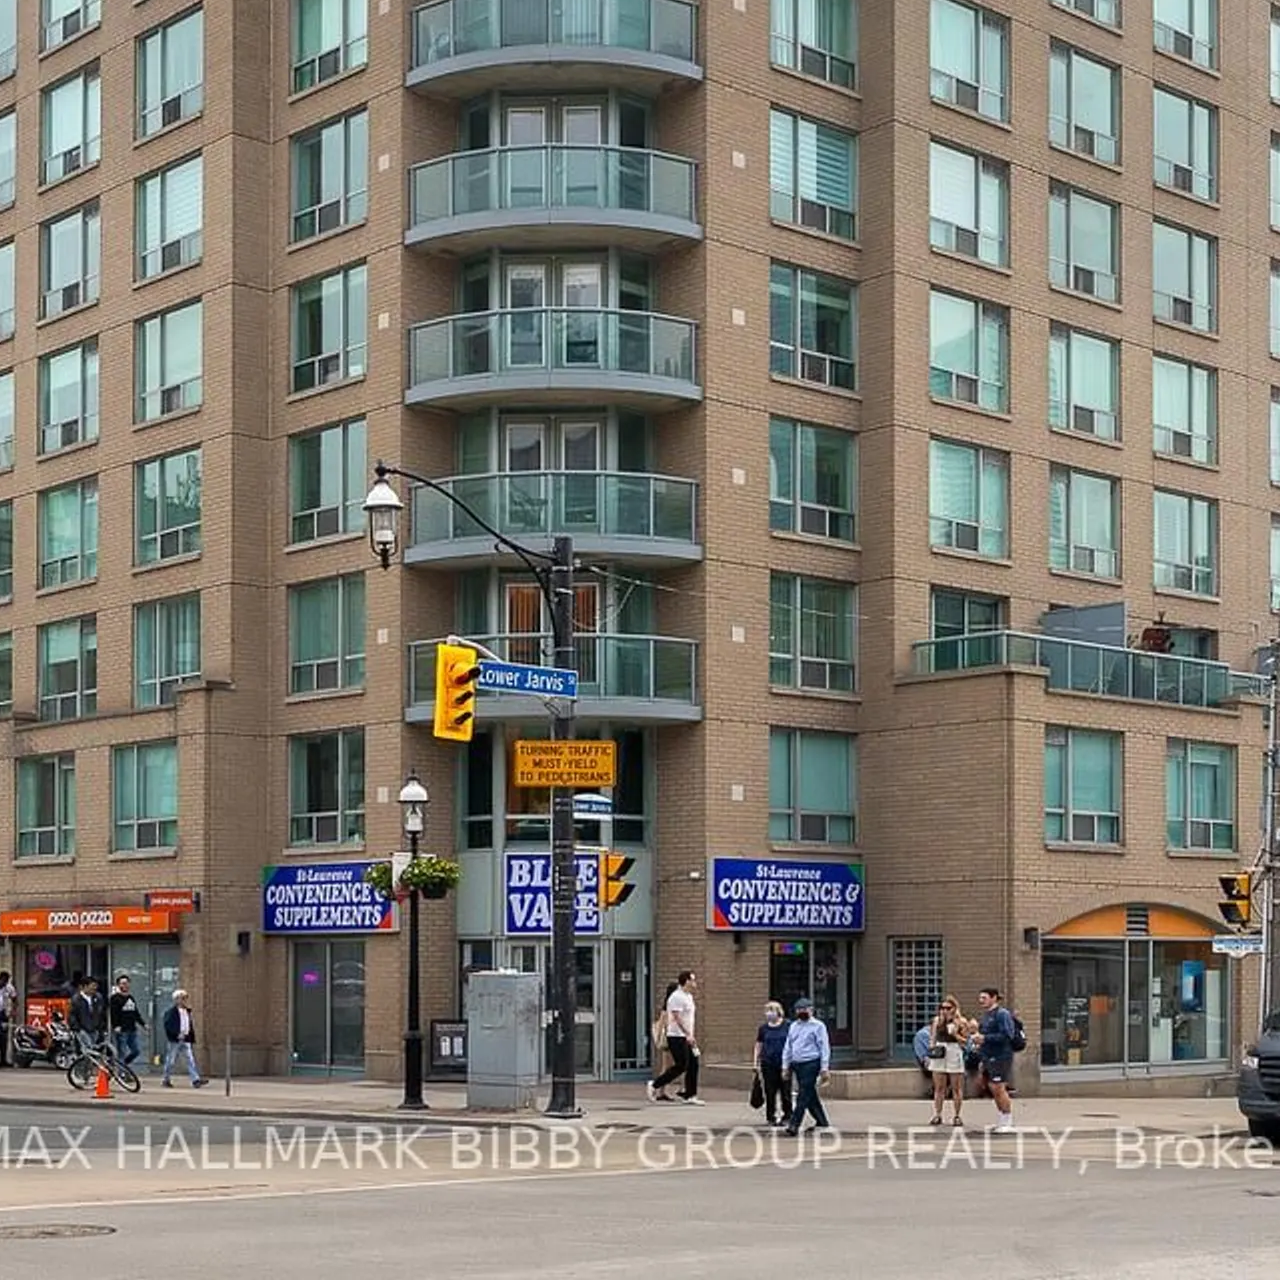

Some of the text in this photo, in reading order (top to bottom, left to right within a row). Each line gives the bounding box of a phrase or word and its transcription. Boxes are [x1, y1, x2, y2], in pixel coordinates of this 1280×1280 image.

[479, 665, 520, 687] Lower
[524, 670, 563, 692] Jarvis
[520, 746, 612, 756] TURNING TRAFFIC
[532, 758, 598, 769] MUST YIELD
[520, 771, 612, 782] TO PEDESTRIANS
[509, 859, 598, 888] BLE
[266, 883, 371, 905] CONVENIENCE
[719, 878, 860, 903] CONVENIENCE &
[48, 912, 79, 930] pizza
[80, 910, 113, 929] pizza
[274, 905, 384, 927] SUPPLEMENTS
[508, 892, 598, 928] VAE
[728, 902, 853, 926] SUPPLEMENTS
